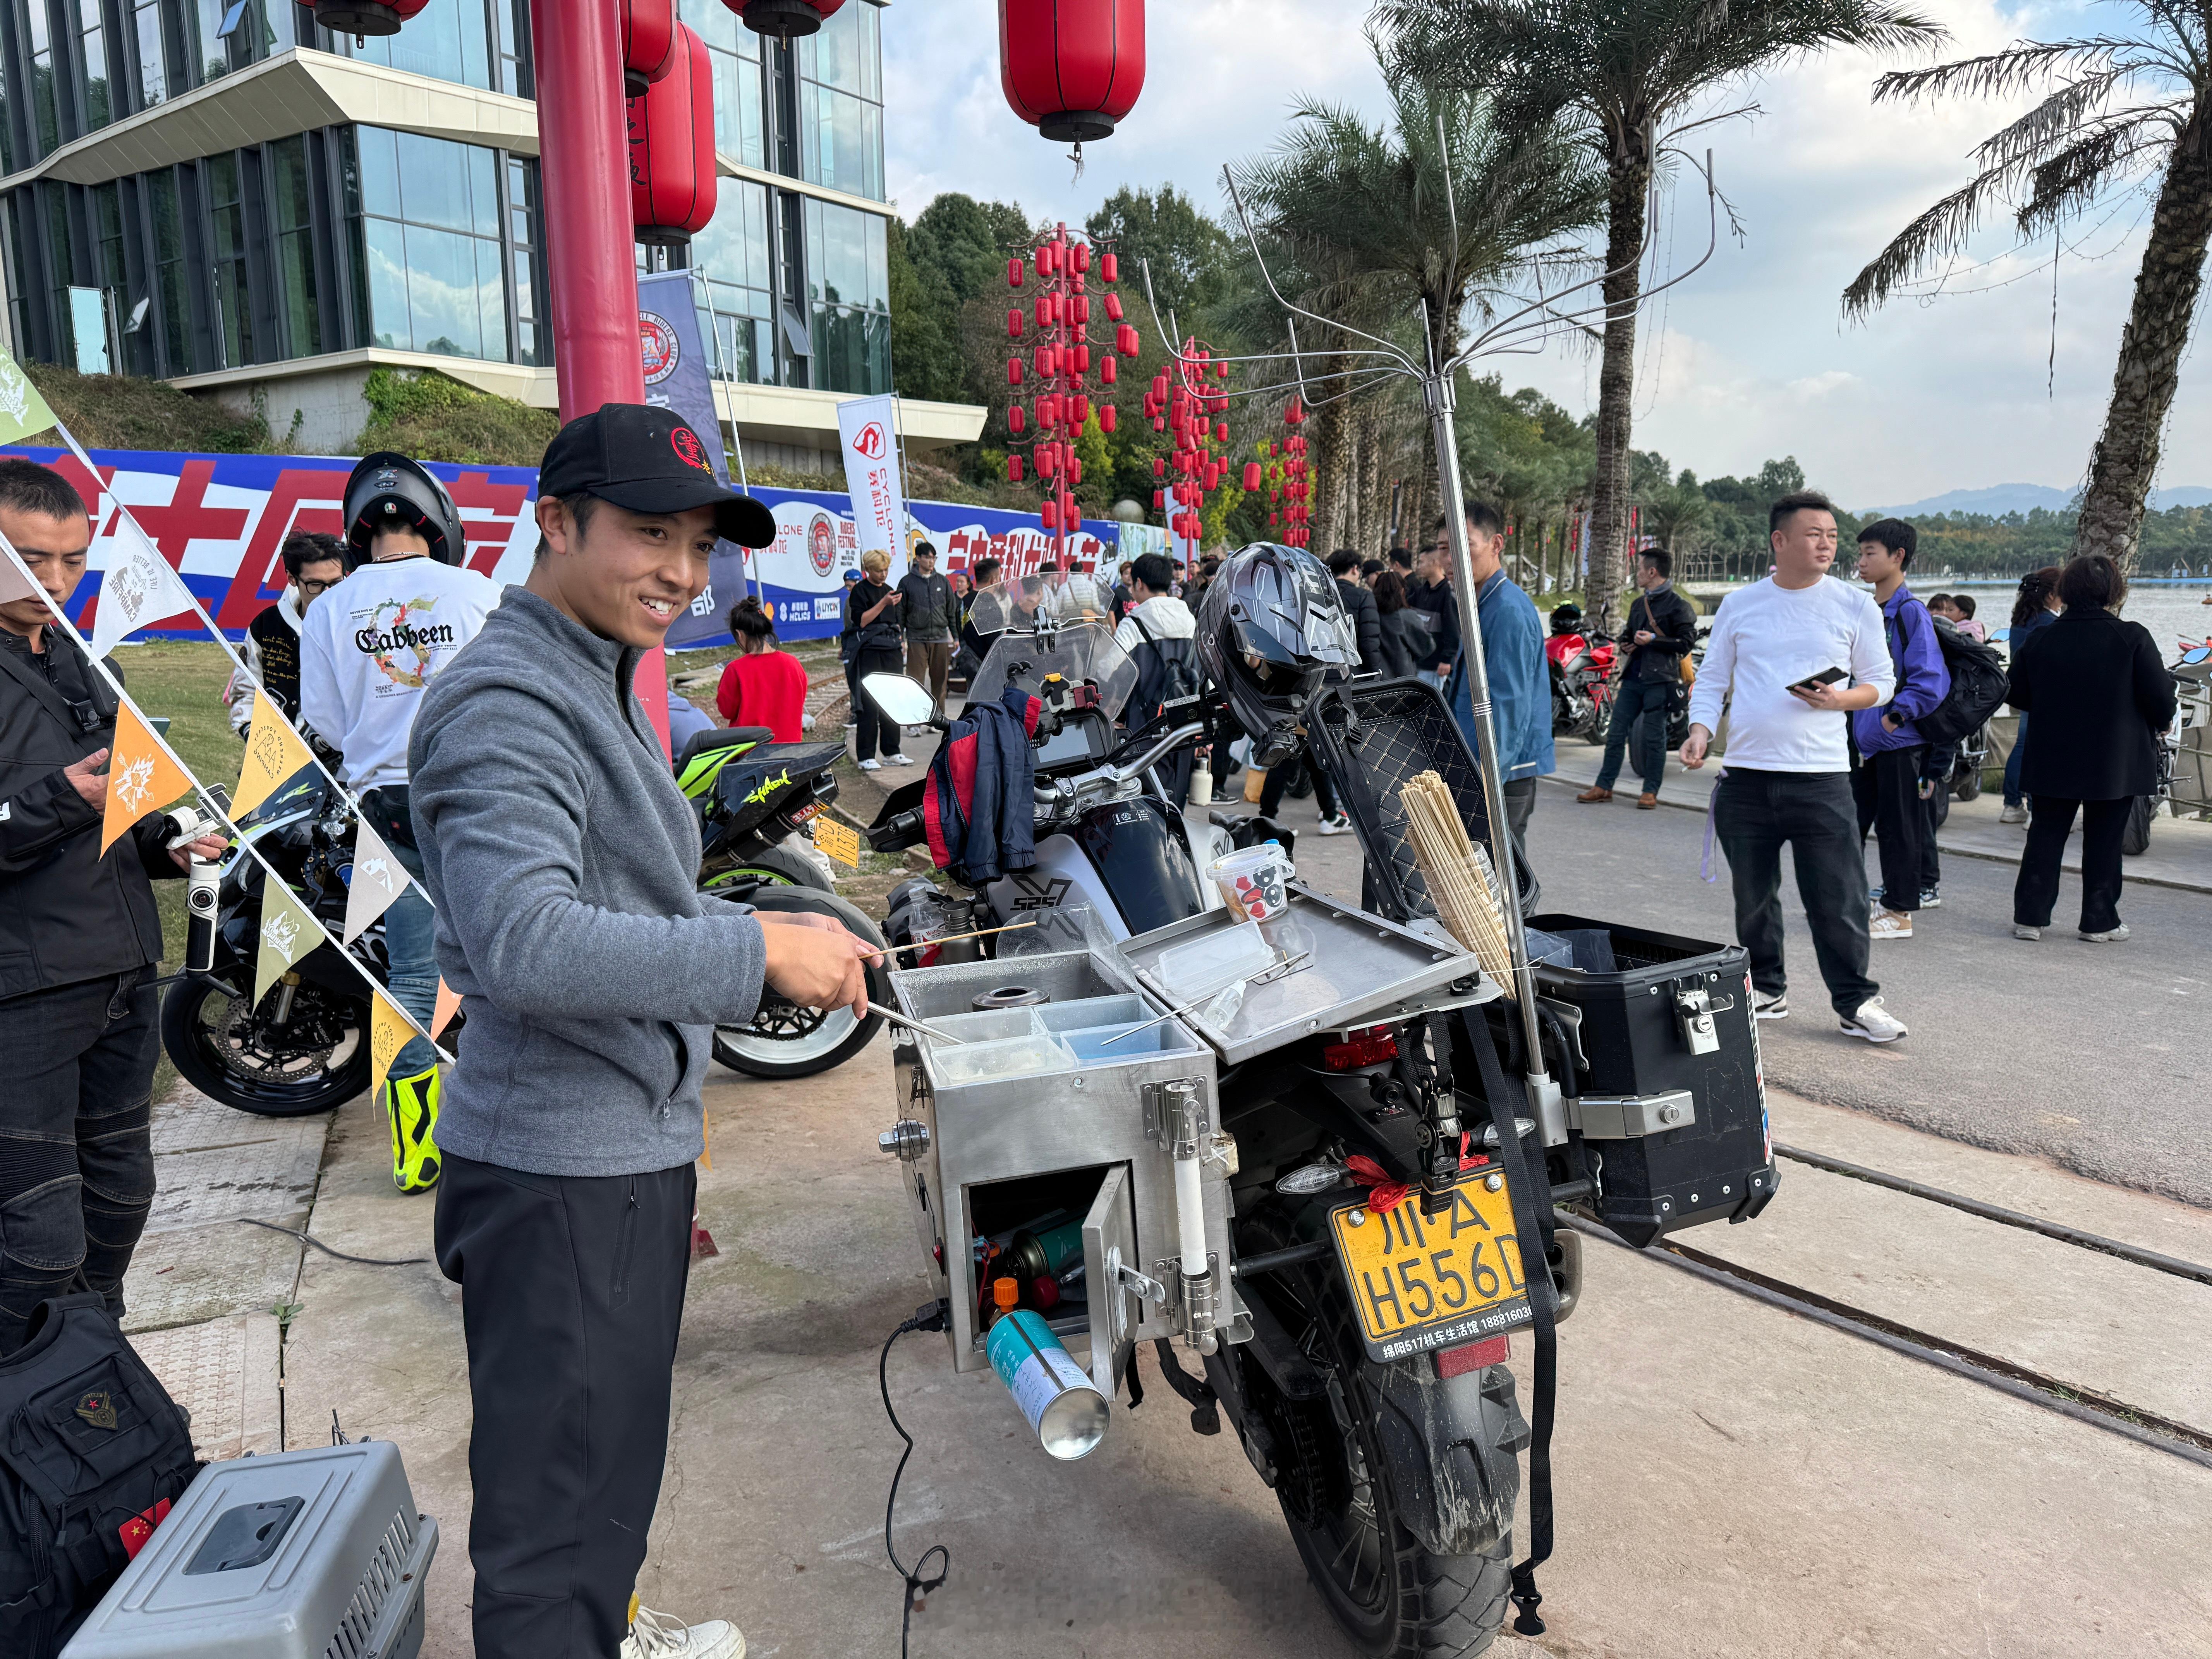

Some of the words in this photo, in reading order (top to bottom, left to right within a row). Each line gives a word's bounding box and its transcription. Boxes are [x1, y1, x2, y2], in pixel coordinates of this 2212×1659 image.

[880, 467, 896, 556] CYCLONE
[775, 524, 803, 536] LONE
[355, 623, 454, 654] Cabbeen
[740, 768, 793, 804] SHARK
[836, 826, 856, 862] Y137G
[1382, 1321, 1480, 1359] 绵阳517机车生活馆
